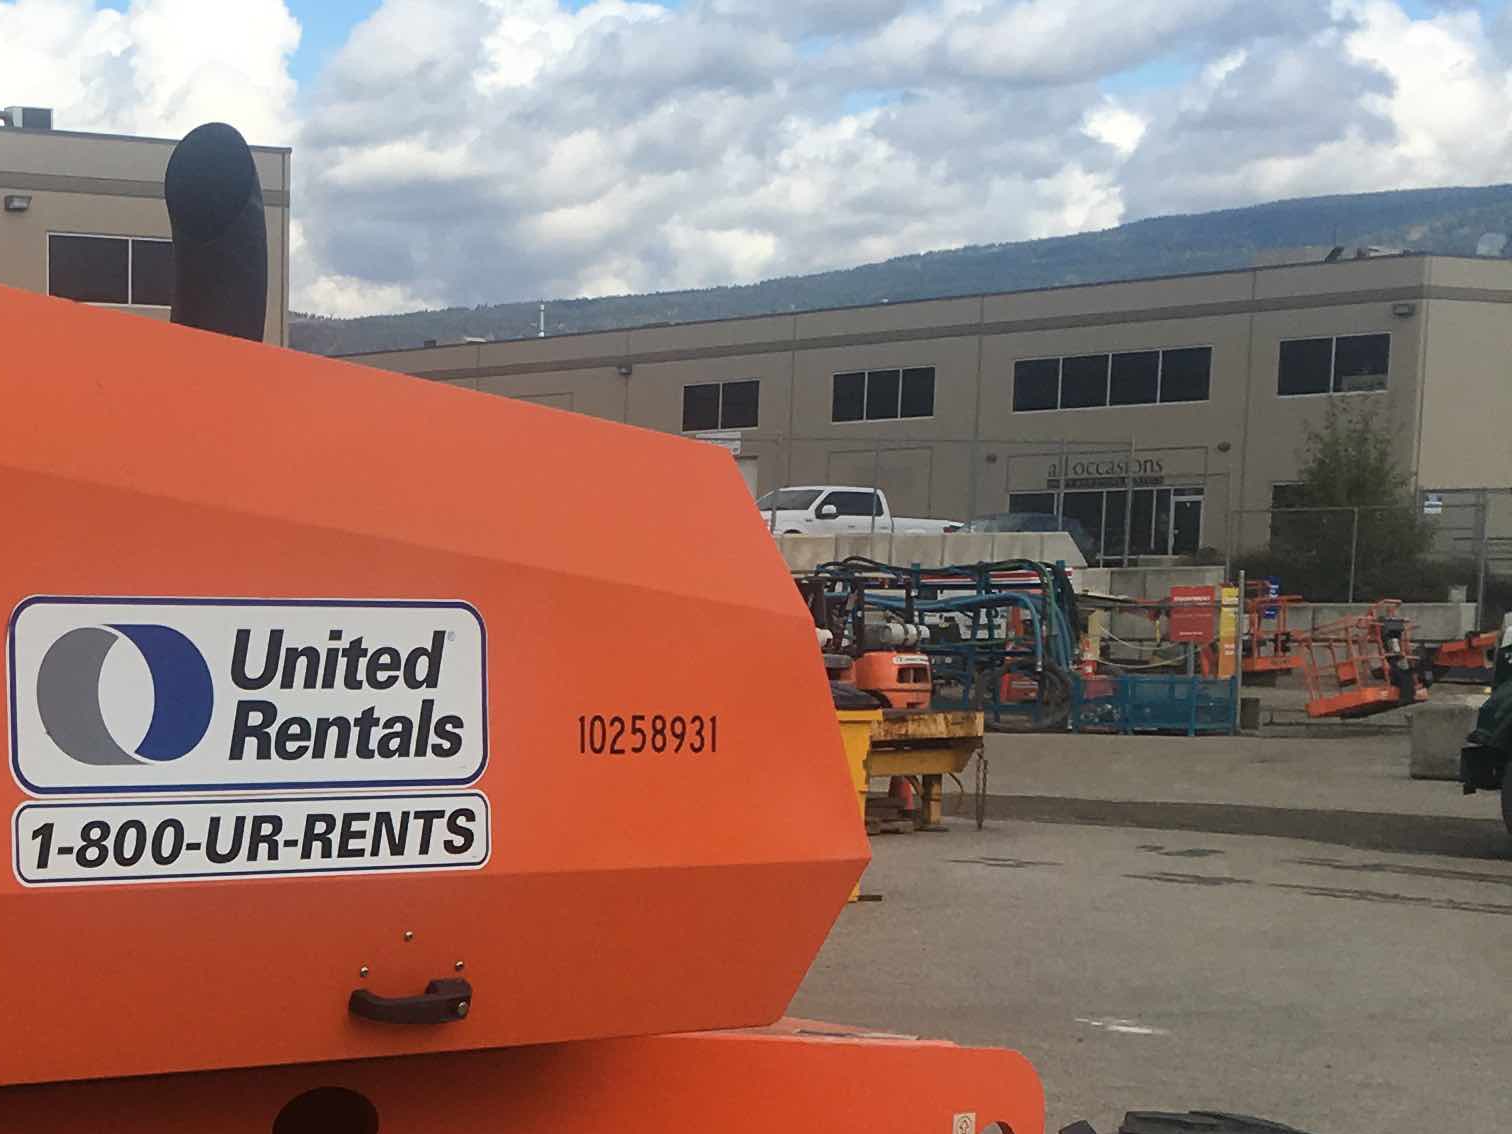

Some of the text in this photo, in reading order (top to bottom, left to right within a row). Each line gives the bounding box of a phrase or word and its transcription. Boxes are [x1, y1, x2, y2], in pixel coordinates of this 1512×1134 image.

[229, 628, 446, 690] United
[228, 699, 464, 761] Rentals
[578, 713, 718, 755] 10258931
[30, 807, 476, 869] 1-800-UR-RENTS
